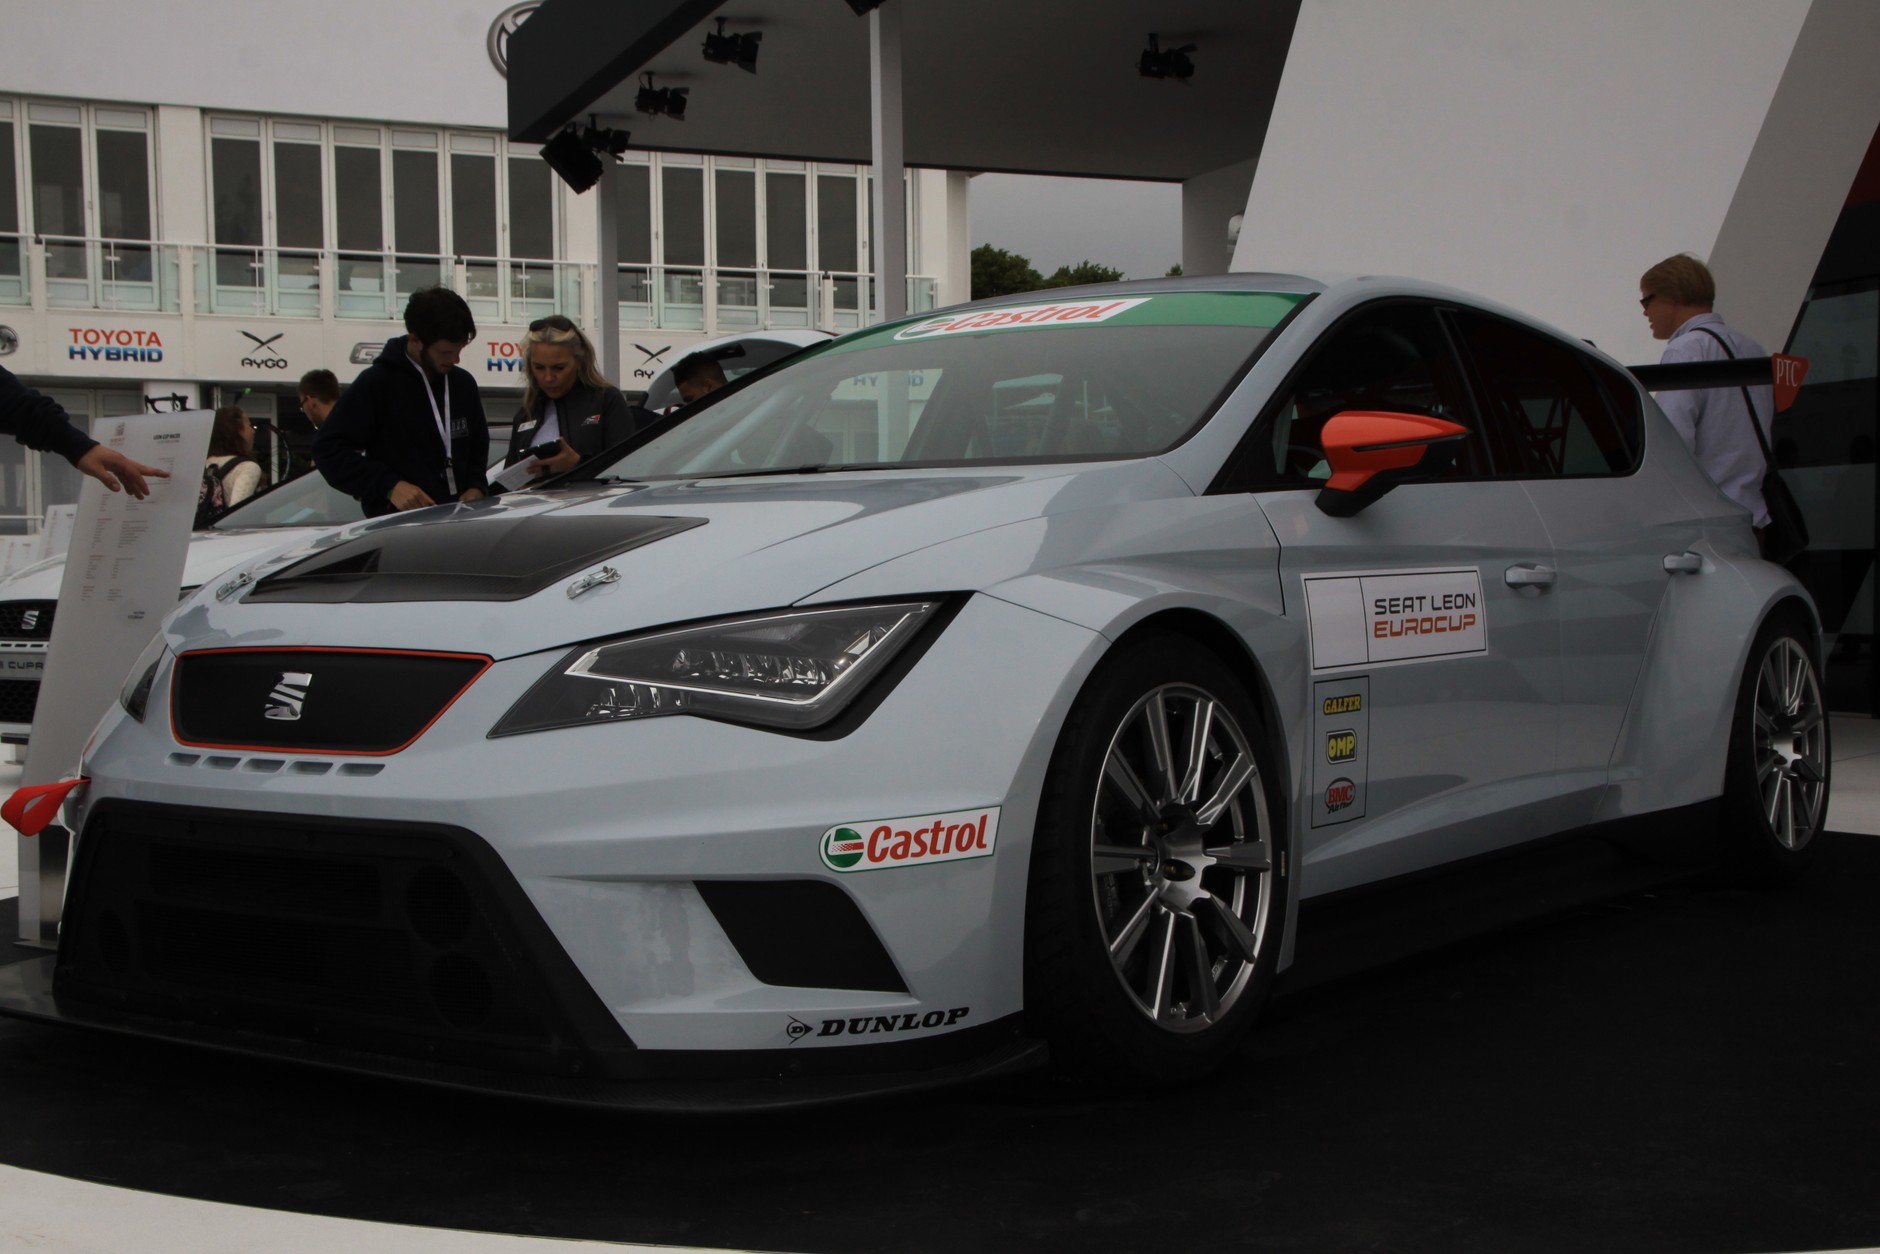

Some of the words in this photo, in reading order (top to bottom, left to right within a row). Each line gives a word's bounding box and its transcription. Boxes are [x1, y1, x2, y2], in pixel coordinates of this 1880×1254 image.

[944, 301, 1125, 332] Castrol
[68, 328, 162, 347] TOYOTA
[68, 346, 163, 363] HYBRID
[487, 342, 524, 357] TOY
[241, 358, 288, 369] AYGO
[1776, 357, 1799, 387] PTC
[634, 368, 655, 380] AY
[1374, 596, 1426, 615] SEAT
[1431, 592, 1476, 611] LEON
[1373, 613, 1476, 638] EUROCUP
[8, 660, 44, 669] CUPR
[1323, 695, 1361, 714] GALFER
[1328, 734, 1355, 758] OMP
[1328, 785, 1353, 804] BMC
[866, 814, 988, 863] Castrol
[816, 1007, 970, 1037] DUNLOP
